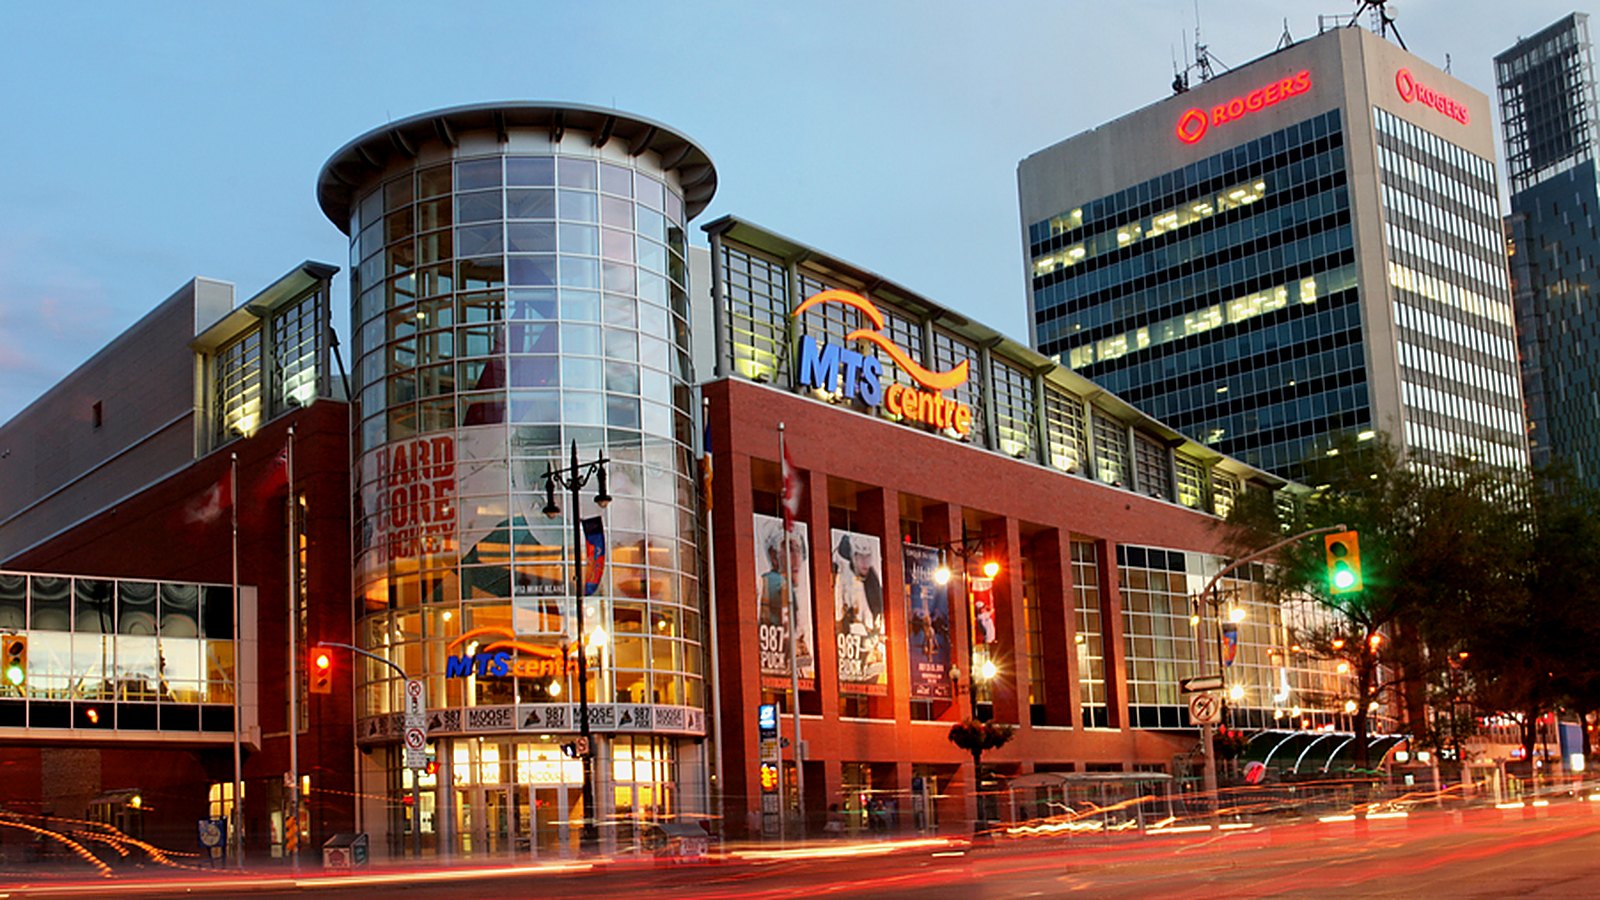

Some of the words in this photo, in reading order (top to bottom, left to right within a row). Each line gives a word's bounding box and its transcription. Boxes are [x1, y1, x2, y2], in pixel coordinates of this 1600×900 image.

[1211, 69, 1312, 127] ROGERS
[1415, 86, 1471, 126] ROGERS
[799, 334, 883, 407] MTS
[885, 382, 972, 436] centre
[376, 435, 455, 491] HARD
[376, 478, 455, 532] CORE
[377, 522, 456, 564] HOCKEY
[759, 624, 785, 652] 987
[837, 633, 861, 660] 987
[446, 651, 512, 679] MTS
[760, 651, 787, 669] PUCK
[838, 658, 863, 676] PUCK
[444, 710, 461, 723] 987
[469, 709, 510, 721] MOOSE
[545, 707, 565, 719] 987
[573, 706, 613, 718] MOSE
[633, 707, 650, 719] 987
[655, 709, 682, 721] MOOSE
[545, 718, 565, 728] PUCK
[634, 718, 650, 728] PUCK
